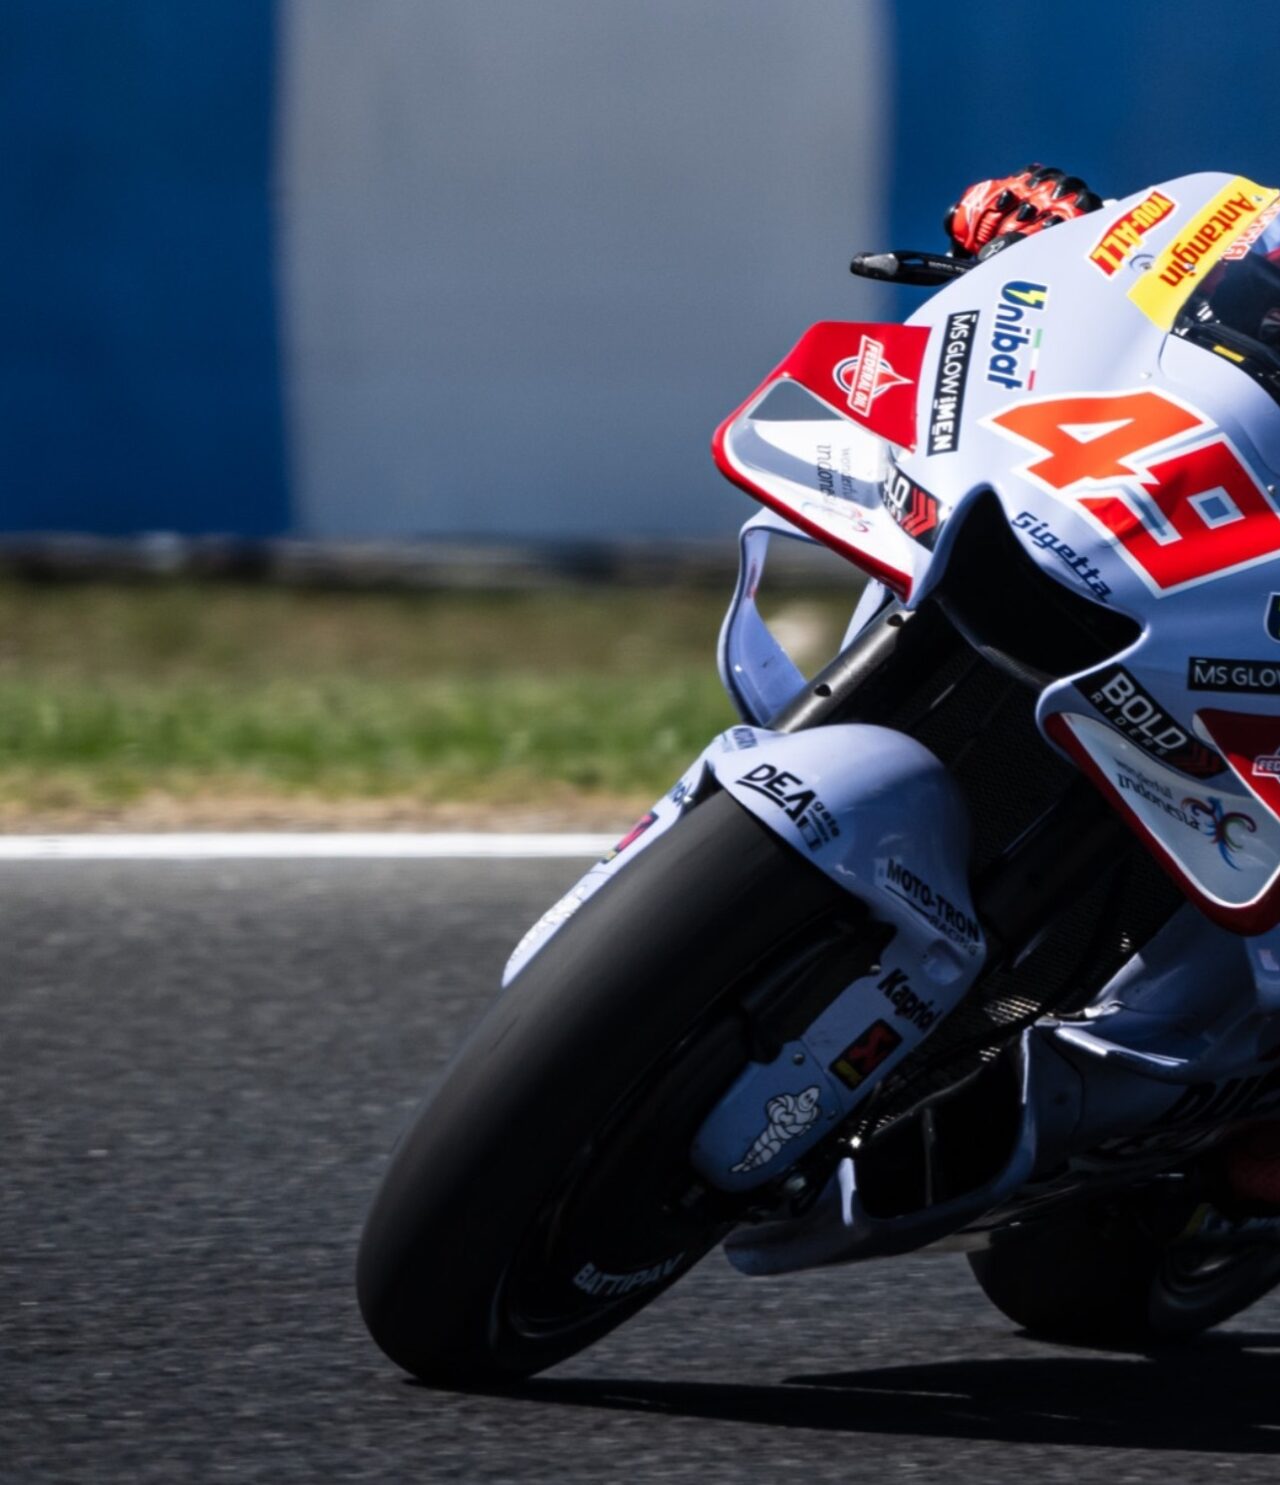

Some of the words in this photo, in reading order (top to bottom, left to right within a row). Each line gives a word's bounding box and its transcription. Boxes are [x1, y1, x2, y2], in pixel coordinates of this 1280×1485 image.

[1092, 193, 1173, 272] YOU-ALL
[1160, 192, 1256, 287] Antangin
[950, 314, 977, 336] MS
[987, 281, 1046, 389] Unibat
[859, 344, 880, 390] FEDERAL
[943, 340, 967, 396] GLOW
[1011, 512, 1111, 595] Gigetta
[1101, 671, 1188, 749] BOLD
[1194, 660, 1228, 685] MS
[742, 764, 815, 820] DEA
[887, 859, 980, 942] MOTO-TRON
